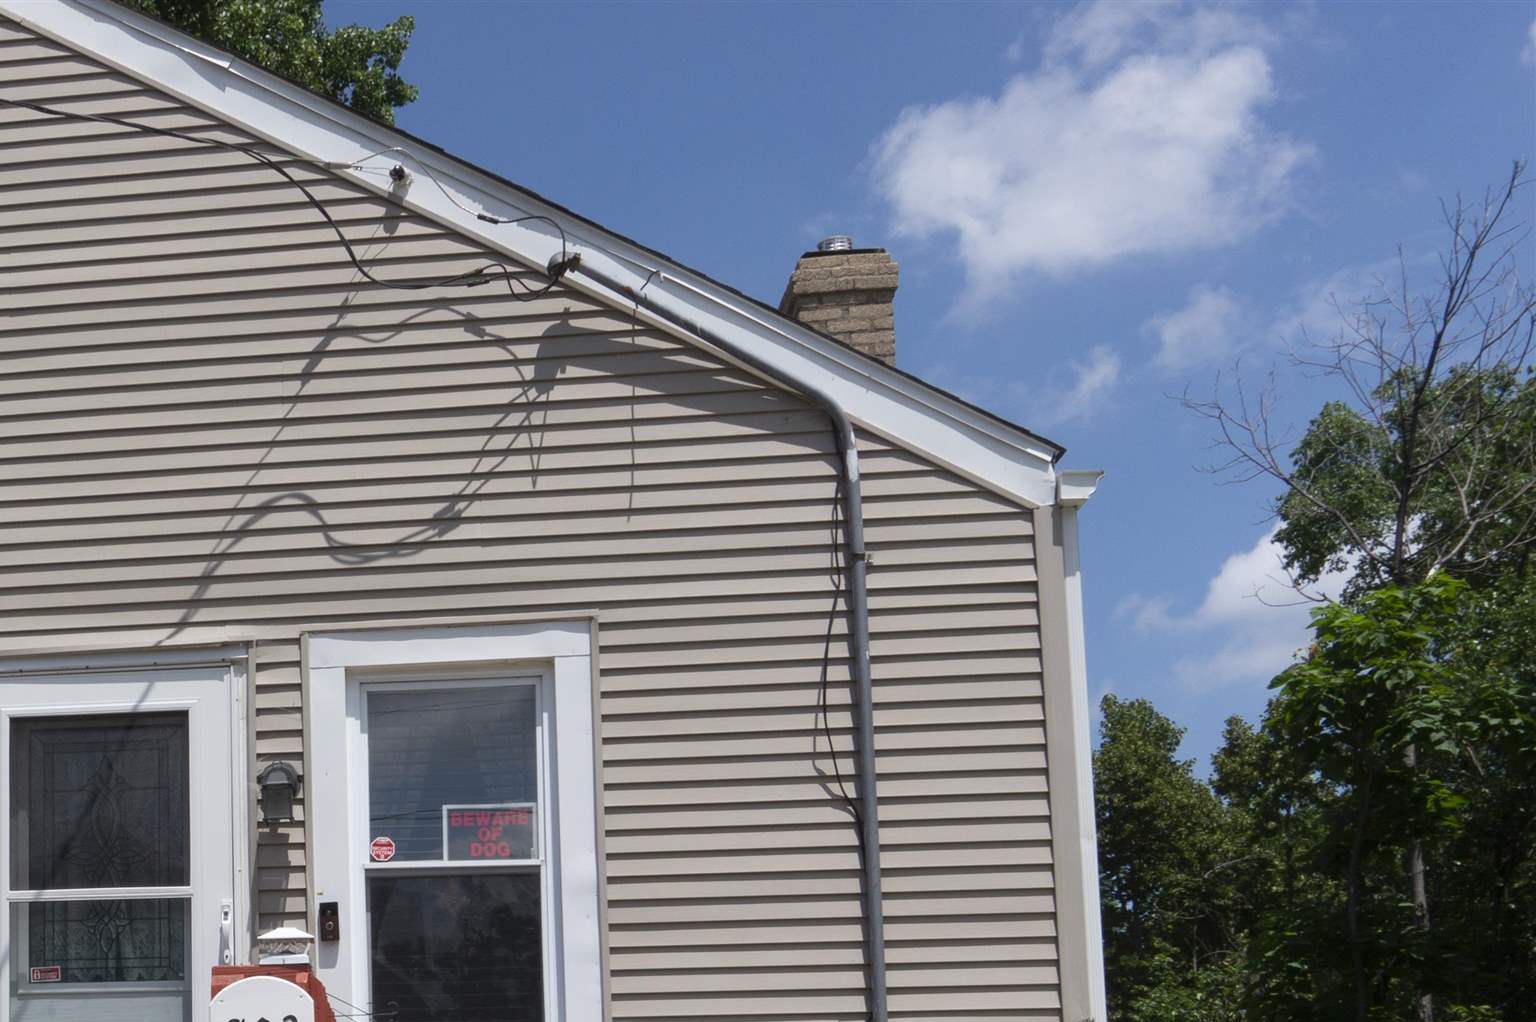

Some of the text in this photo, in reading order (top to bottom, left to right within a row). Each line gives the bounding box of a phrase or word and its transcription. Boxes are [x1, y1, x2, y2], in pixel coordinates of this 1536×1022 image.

[451, 810, 528, 827] BEWARE
[478, 827, 503, 841] OF
[470, 842, 511, 857] DOG
